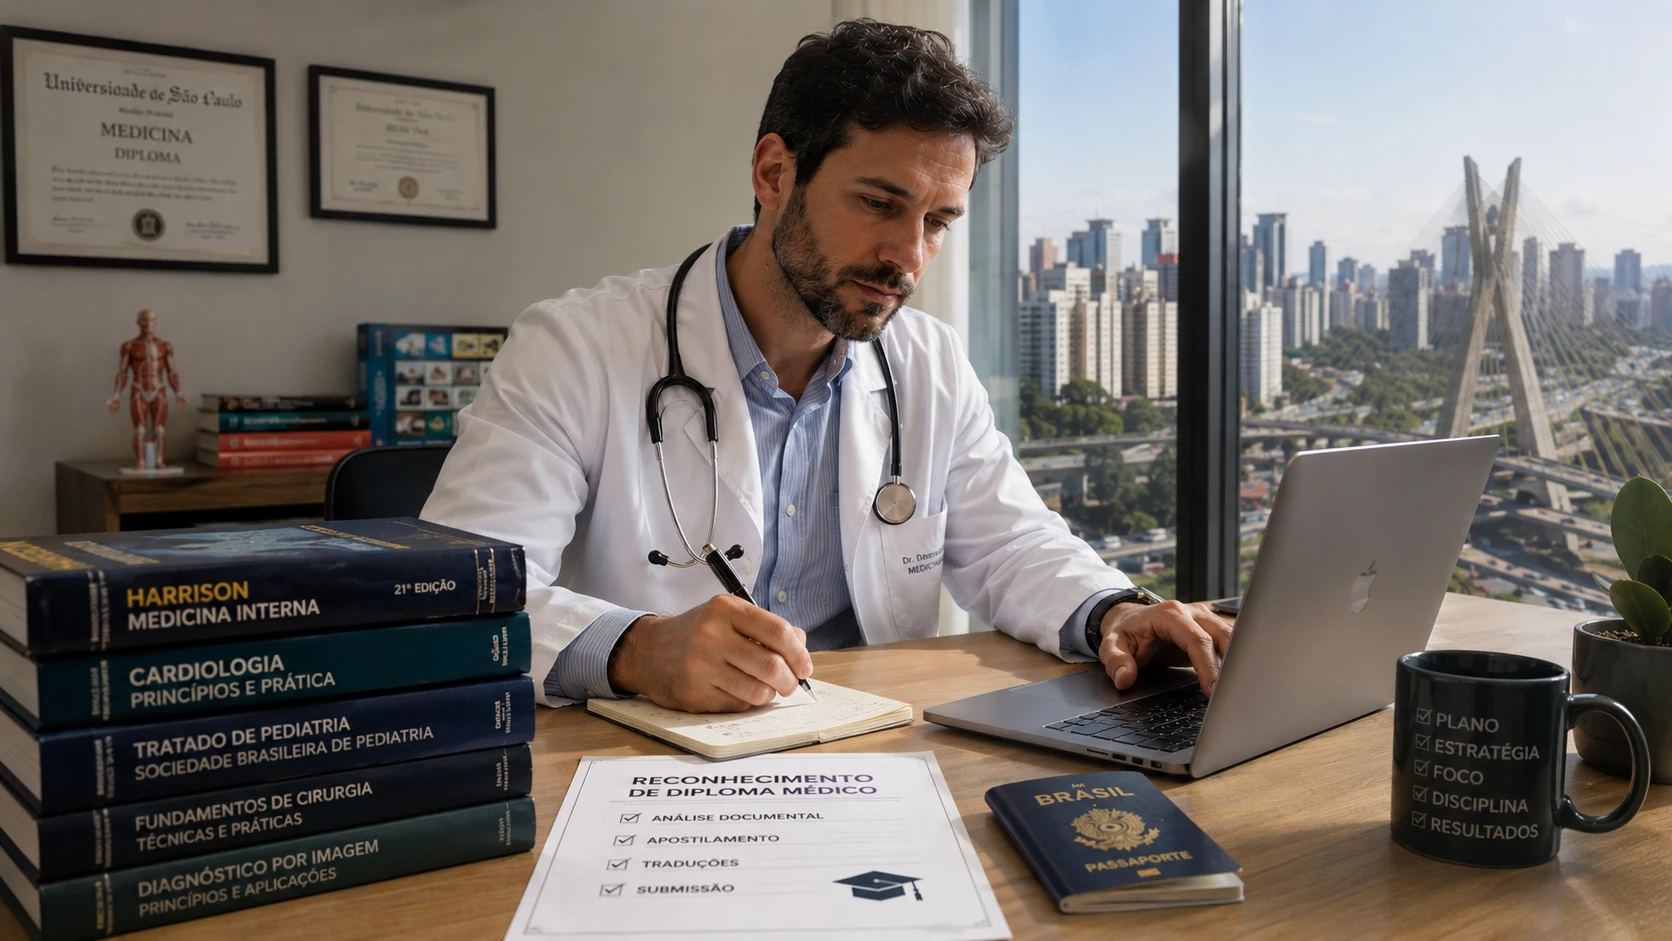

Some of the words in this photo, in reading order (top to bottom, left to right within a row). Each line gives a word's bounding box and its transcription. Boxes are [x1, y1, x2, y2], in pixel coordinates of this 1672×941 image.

[150, 88, 165, 102] de
[167, 85, 198, 106] São
[202, 92, 242, 109] Paulo
[100, 122, 193, 144] MEDICINA
[115, 147, 181, 164] DIPLOMA
[902, 556, 914, 564] Dr.
[127, 581, 249, 608] HARRISON
[415, 579, 456, 595] EDIÇÃO
[128, 606, 231, 631] MEDICINA
[237, 598, 320, 622] INTERNA
[129, 654, 285, 687] CARDIOLOGIA
[130, 680, 240, 709] PRINCÍPIOS
[246, 680, 256, 696] E
[261, 671, 336, 692] PRÁTICA
[1436, 712, 1499, 733] PLANO
[133, 732, 226, 760] TRATADO
[232, 729, 255, 747] DE
[261, 717, 351, 742] PEDIATRIA
[1435, 738, 1540, 760] ESTRATÉGIA
[135, 750, 232, 781] SOCIEDADE
[238, 740, 328, 766] BRASILEIRA
[332, 737, 351, 753] DE
[356, 726, 434, 748] PEDIATRIA
[632, 774, 874, 786] RECONHECIMENTO
[1433, 765, 1484, 786] FOCO
[628, 788, 660, 798] DE
[666, 787, 776, 798] DIPLOMA
[782, 784, 878, 796] MÉDICO
[1034, 786, 1134, 806] BRASIL
[1432, 791, 1529, 813] DISCIPLINA
[135, 797, 267, 832] FUNDAMENTOS
[272, 794, 292, 810] DE
[297, 782, 373, 806] CIRURGIA
[651, 812, 715, 822] ANÁLISE
[718, 812, 825, 822] DOCUMENTAL
[136, 825, 214, 852] TÉCNICAS
[218, 824, 228, 838] E
[232, 812, 302, 837] PRÁTICAS
[646, 834, 780, 845] APOSTILAMENTO
[1430, 817, 1539, 840] RESULTADOS
[138, 860, 268, 898] DIAGNÓSTICO
[272, 852, 307, 873] POR
[312, 838, 379, 864] IMAGEM
[642, 858, 740, 870] TRADUÇÕES
[1084, 850, 1193, 873] PASSAPORTE
[139, 886, 228, 917] PRINCÍPIOS
[232, 884, 242, 900] E
[244, 867, 337, 896] APLICAÇÕES
[636, 882, 736, 894] SUBMISSÃO
